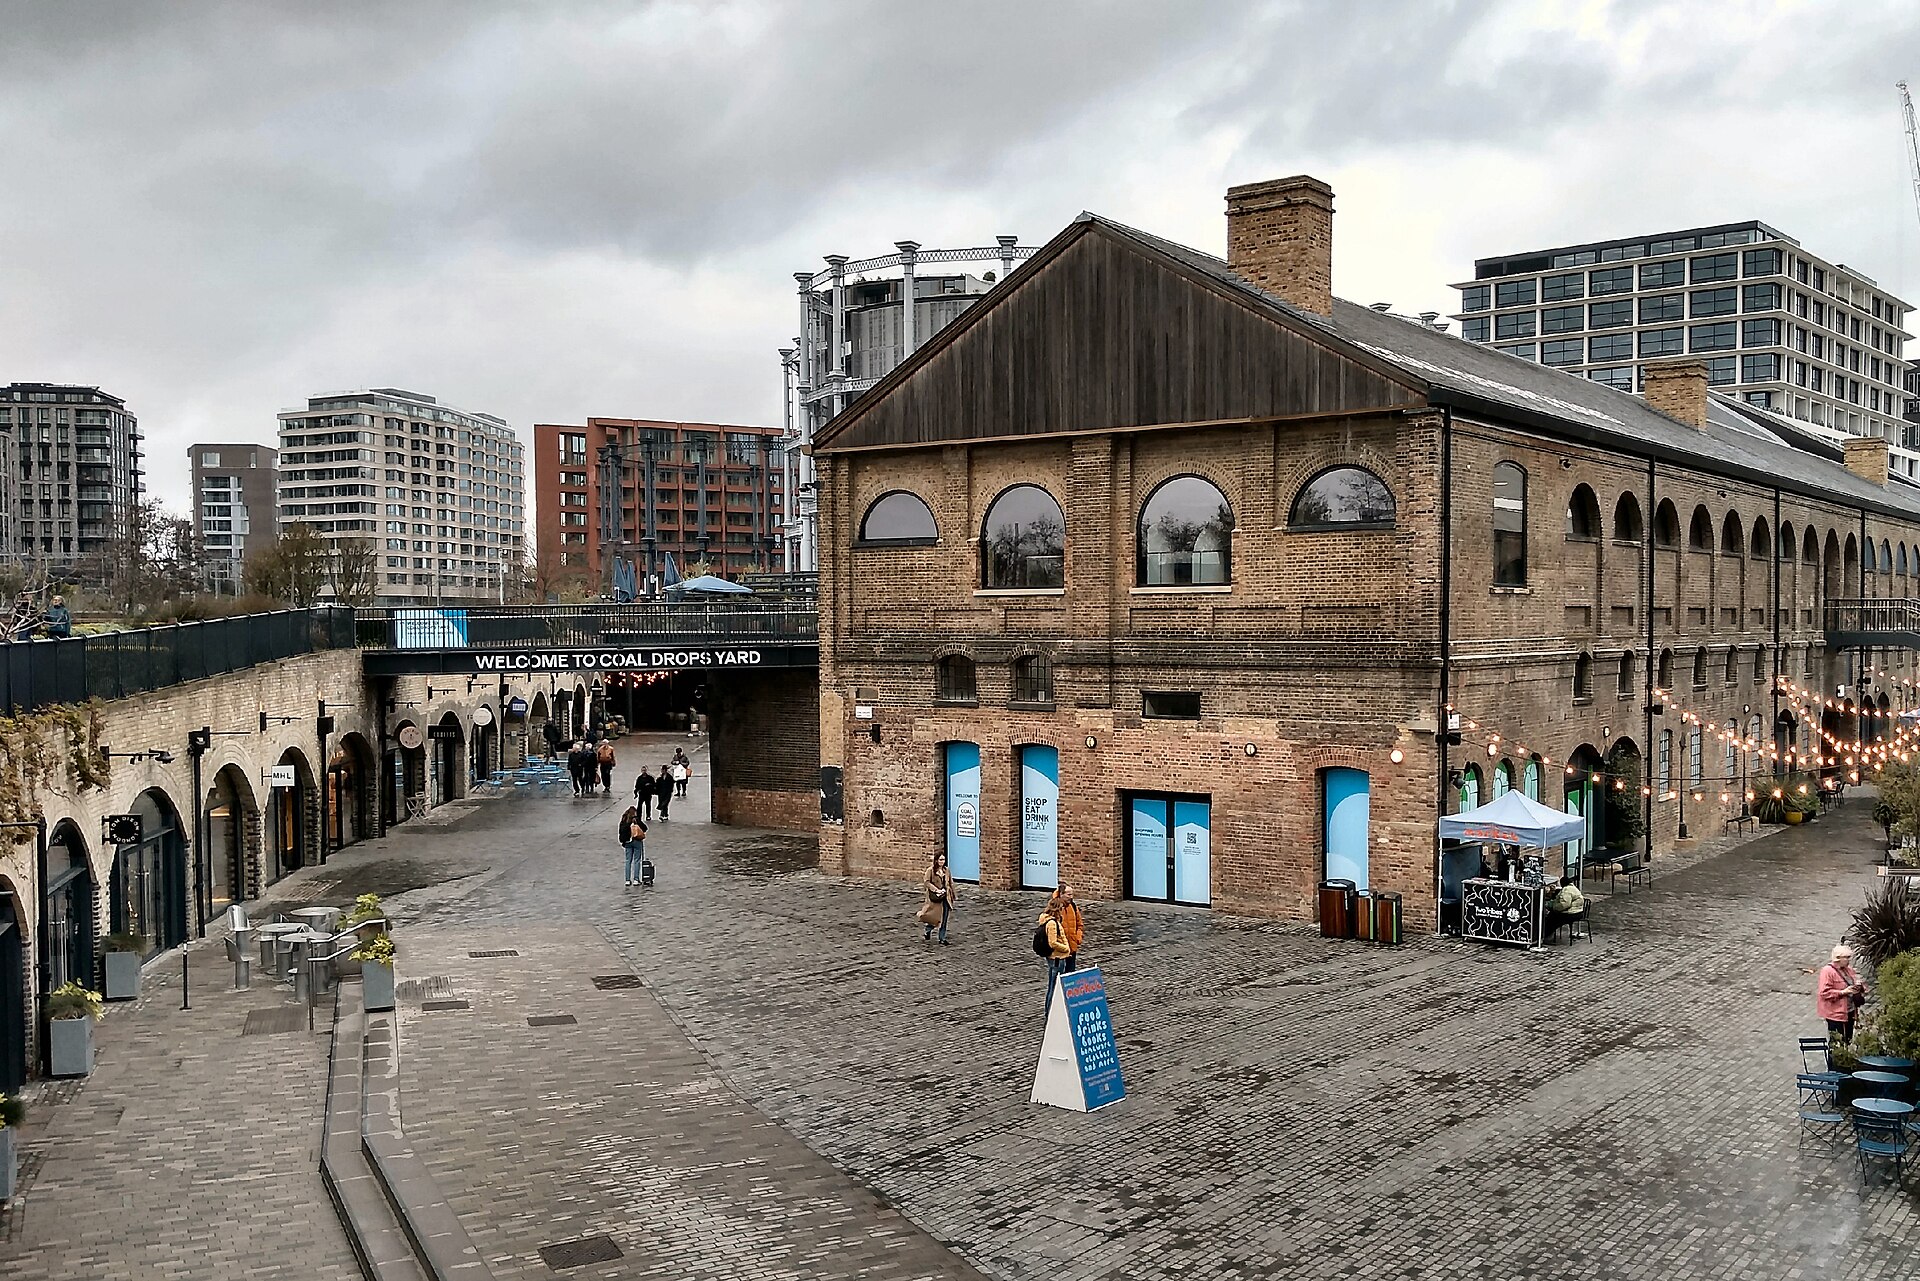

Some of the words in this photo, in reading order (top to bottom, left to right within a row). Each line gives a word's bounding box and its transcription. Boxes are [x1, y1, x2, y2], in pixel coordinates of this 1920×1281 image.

[475, 654, 569, 669] WELCOME
[572, 653, 596, 669] TO
[599, 653, 648, 668] COAL
[651, 651, 711, 667] DROPS
[715, 650, 761, 665] YARD
[1025, 797, 1048, 806] SHOP
[1025, 805, 1040, 814] EAT
[1025, 813, 1050, 822] DRINK
[1025, 821, 1047, 830] PLAY
[1025, 858, 1038, 866] THIS
[1039, 859, 1052, 867] WAY
[1079, 1006, 1101, 1025] food
[1077, 1020, 1107, 1037] drinks
[1081, 1032, 1107, 1047] books
[1084, 1061, 1096, 1072] and
